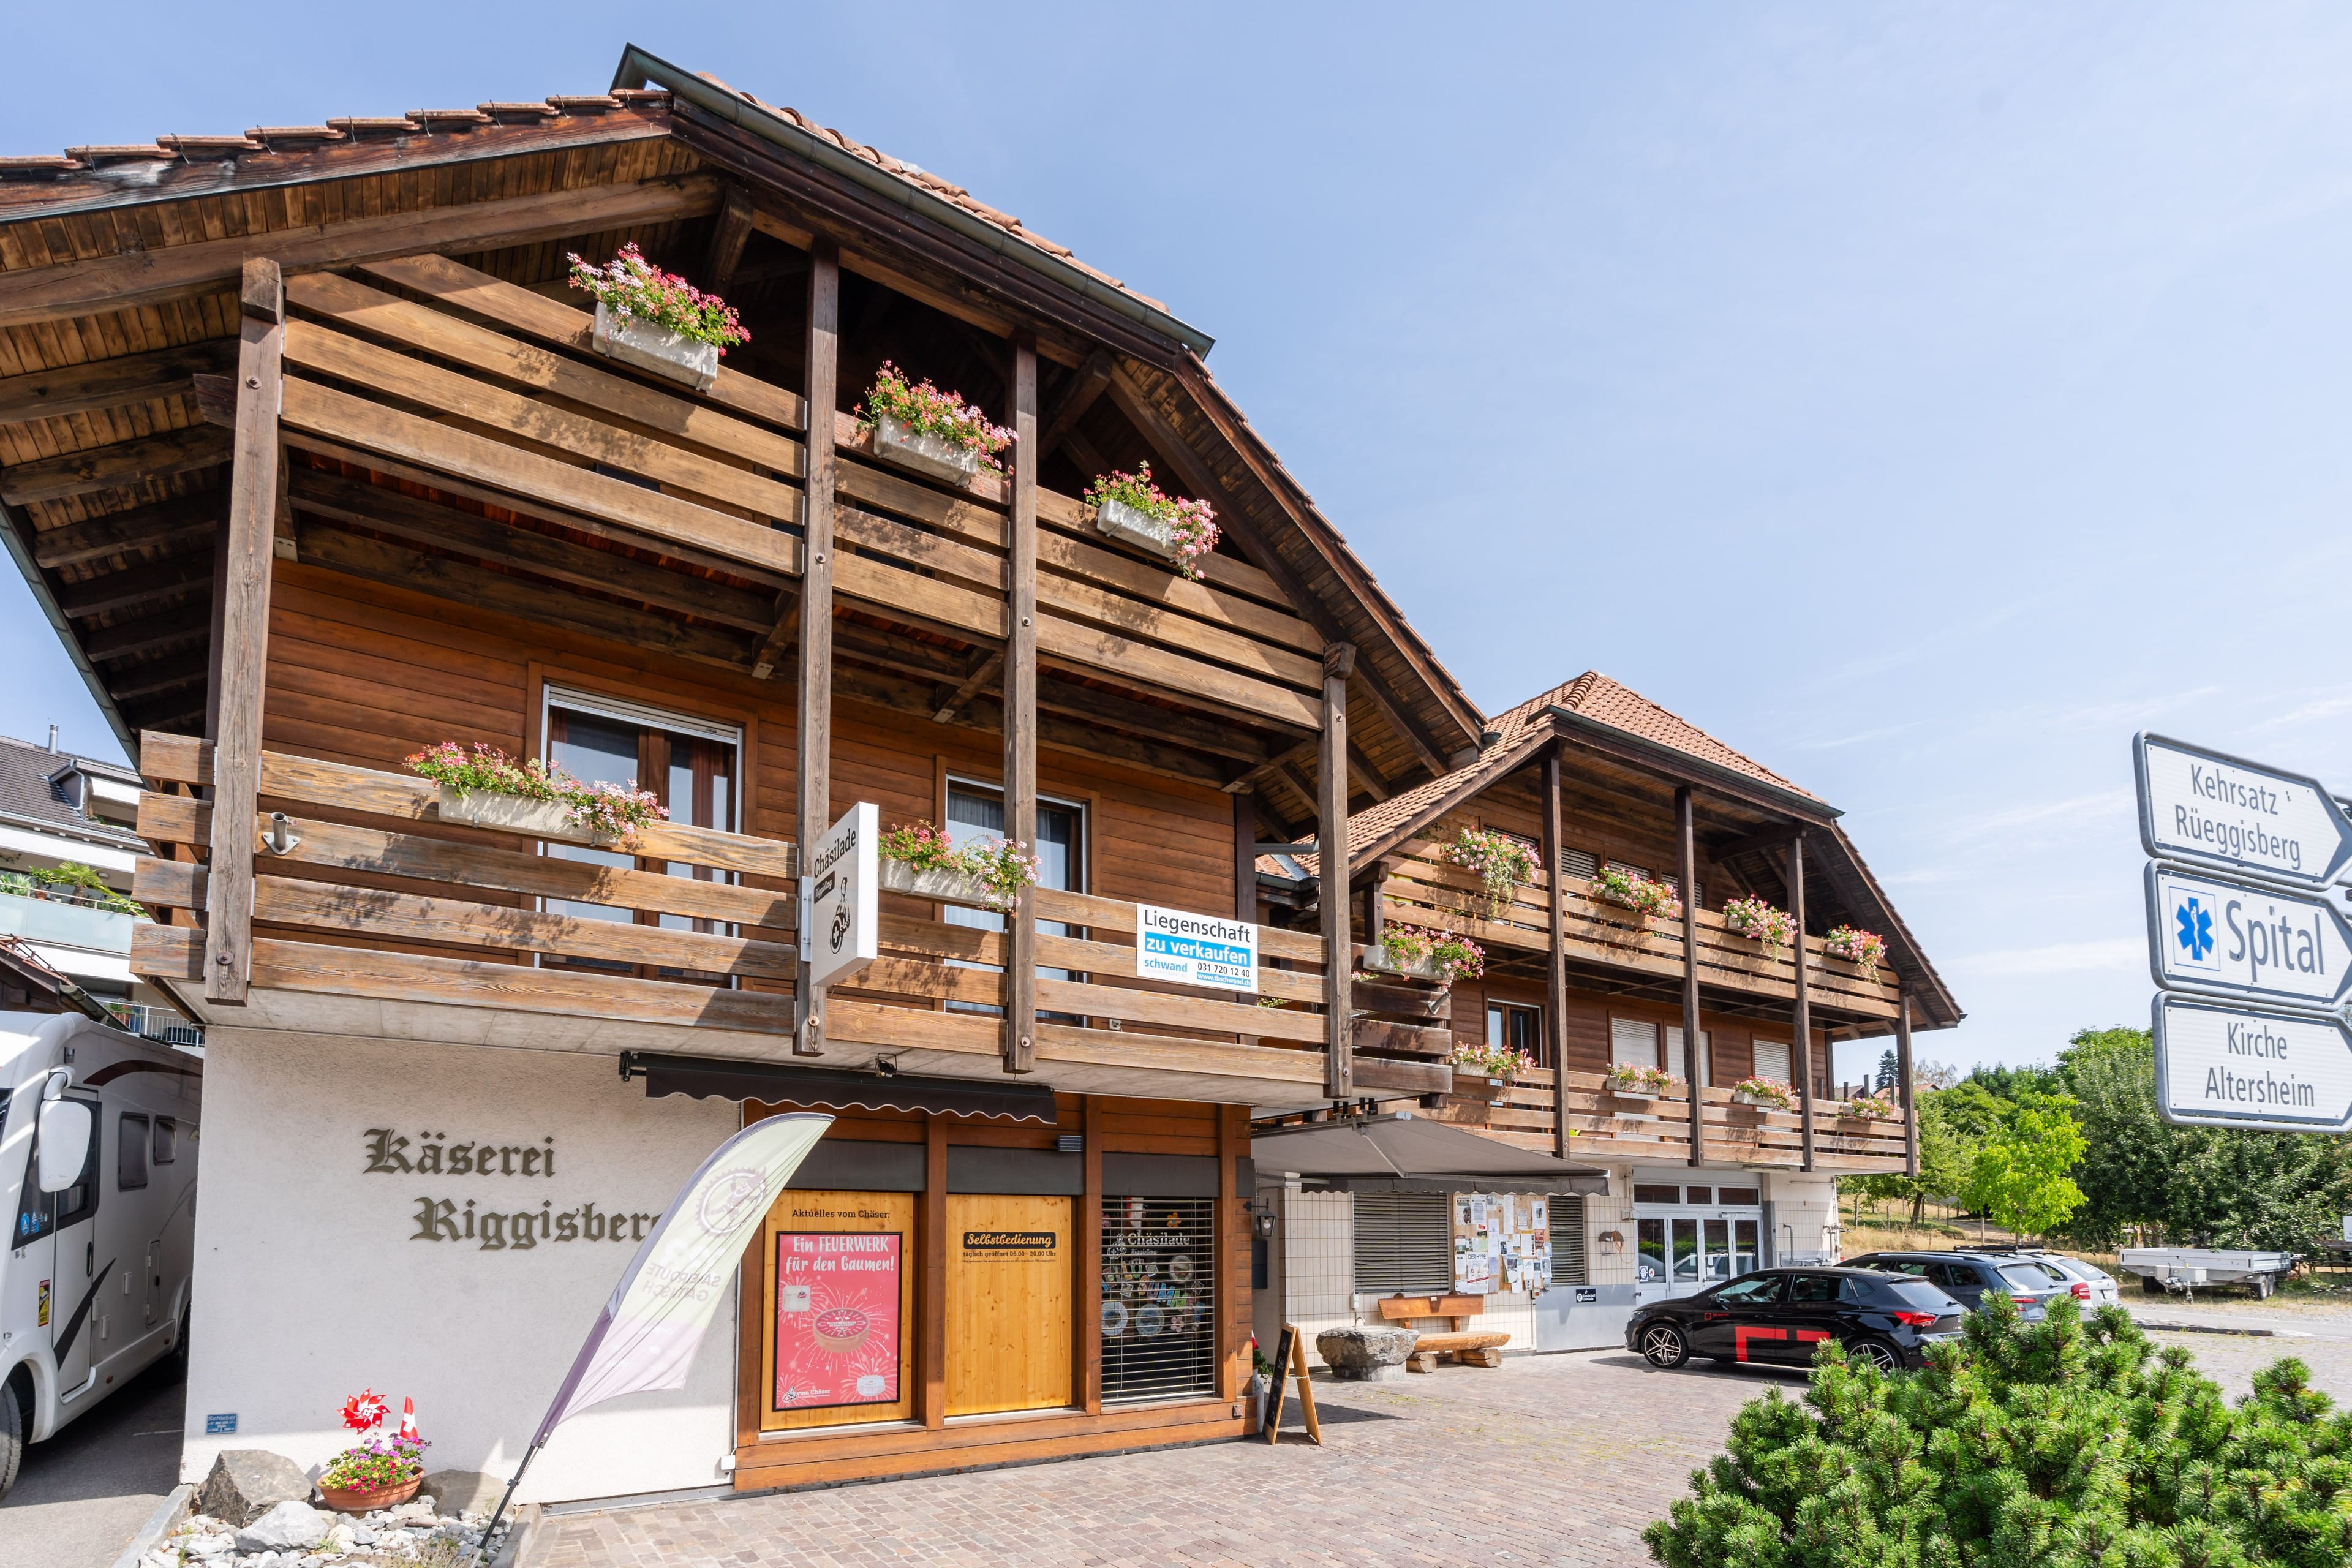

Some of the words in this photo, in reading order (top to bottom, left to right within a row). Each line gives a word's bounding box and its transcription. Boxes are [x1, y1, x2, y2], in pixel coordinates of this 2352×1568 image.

[2190, 763, 2278, 816] Kehrsatz
[2174, 804, 2301, 870] Rüeggisberg
[814, 827, 856, 879] Chäsilade
[1144, 909, 1251, 943] Liegenschaft
[2226, 900, 2324, 982] Spital
[1144, 959, 1188, 973] schwand
[1147, 938, 1166, 952] zu
[1170, 941, 1247, 965] verkaufen
[1197, 962, 1211, 971] 031
[1215, 965, 1227, 974] 720
[1231, 967, 1238, 976] 12
[1197, 973, 1251, 986] www.tbschwand.ch
[2226, 1022, 2288, 1060] Kirche
[2205, 1066, 2315, 1107] Altersheim
[362, 1128, 556, 1178] Käserei
[409, 1197, 664, 1251] Riggisber
[792, 1209, 835, 1218] Aktuelles
[858, 1209, 890, 1219] Chäser:
[793, 1236, 813, 1253] Ein
[819, 1236, 889, 1253] FEUERWERK
[967, 1233, 1053, 1248] Selbstbedienung
[1128, 1232, 1190, 1245] Chäsilade
[785, 1256, 809, 1275] für
[813, 1256, 836, 1272] den
[841, 1256, 894, 1272] Gaumen!
